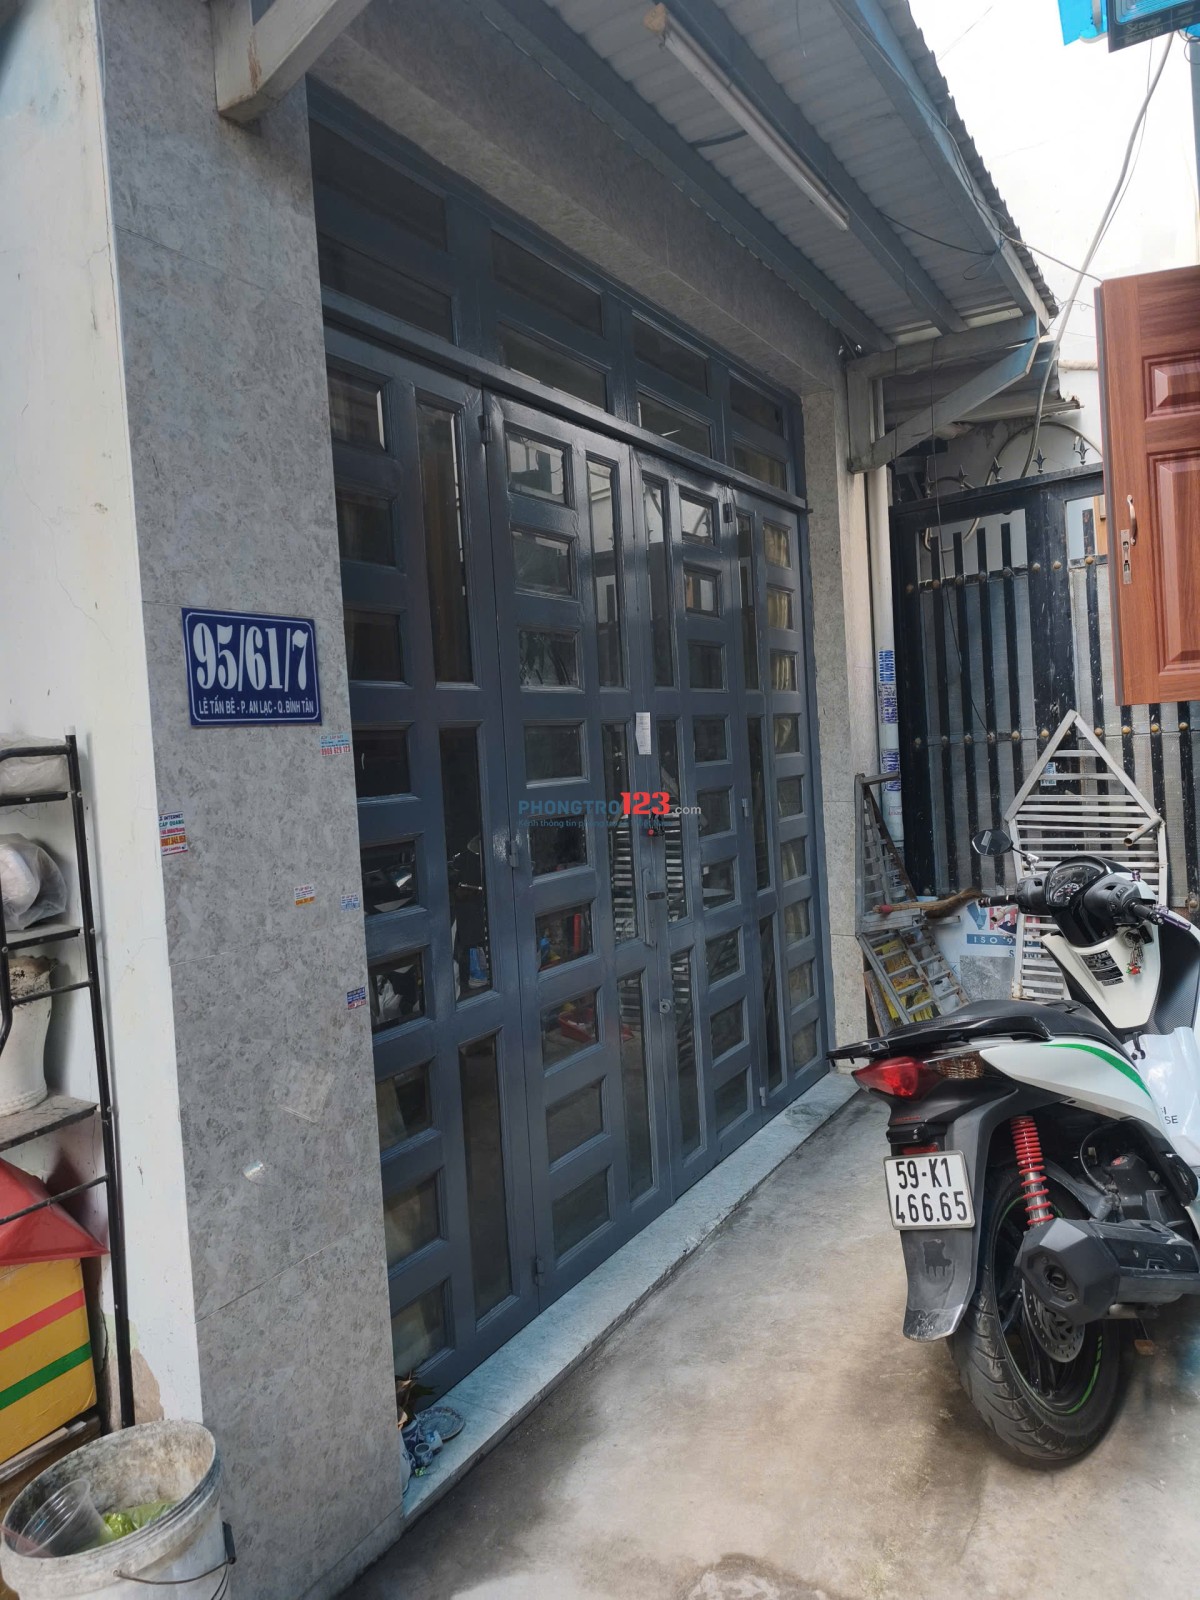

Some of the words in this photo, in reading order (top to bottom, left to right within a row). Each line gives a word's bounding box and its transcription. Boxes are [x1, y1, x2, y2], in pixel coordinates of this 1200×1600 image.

[192, 622, 309, 692] 95/61/7
[198, 697, 208, 714] LÊ
[209, 694, 225, 714] TẤN
[249, 700, 259, 714] AN
[259, 700, 273, 716] LẠC
[301, 697, 314, 713] TÂN
[973, 936, 998, 944] ISO
[895, 1157, 952, 1189] 59-K1
[895, 1190, 968, 1223] 466.65
